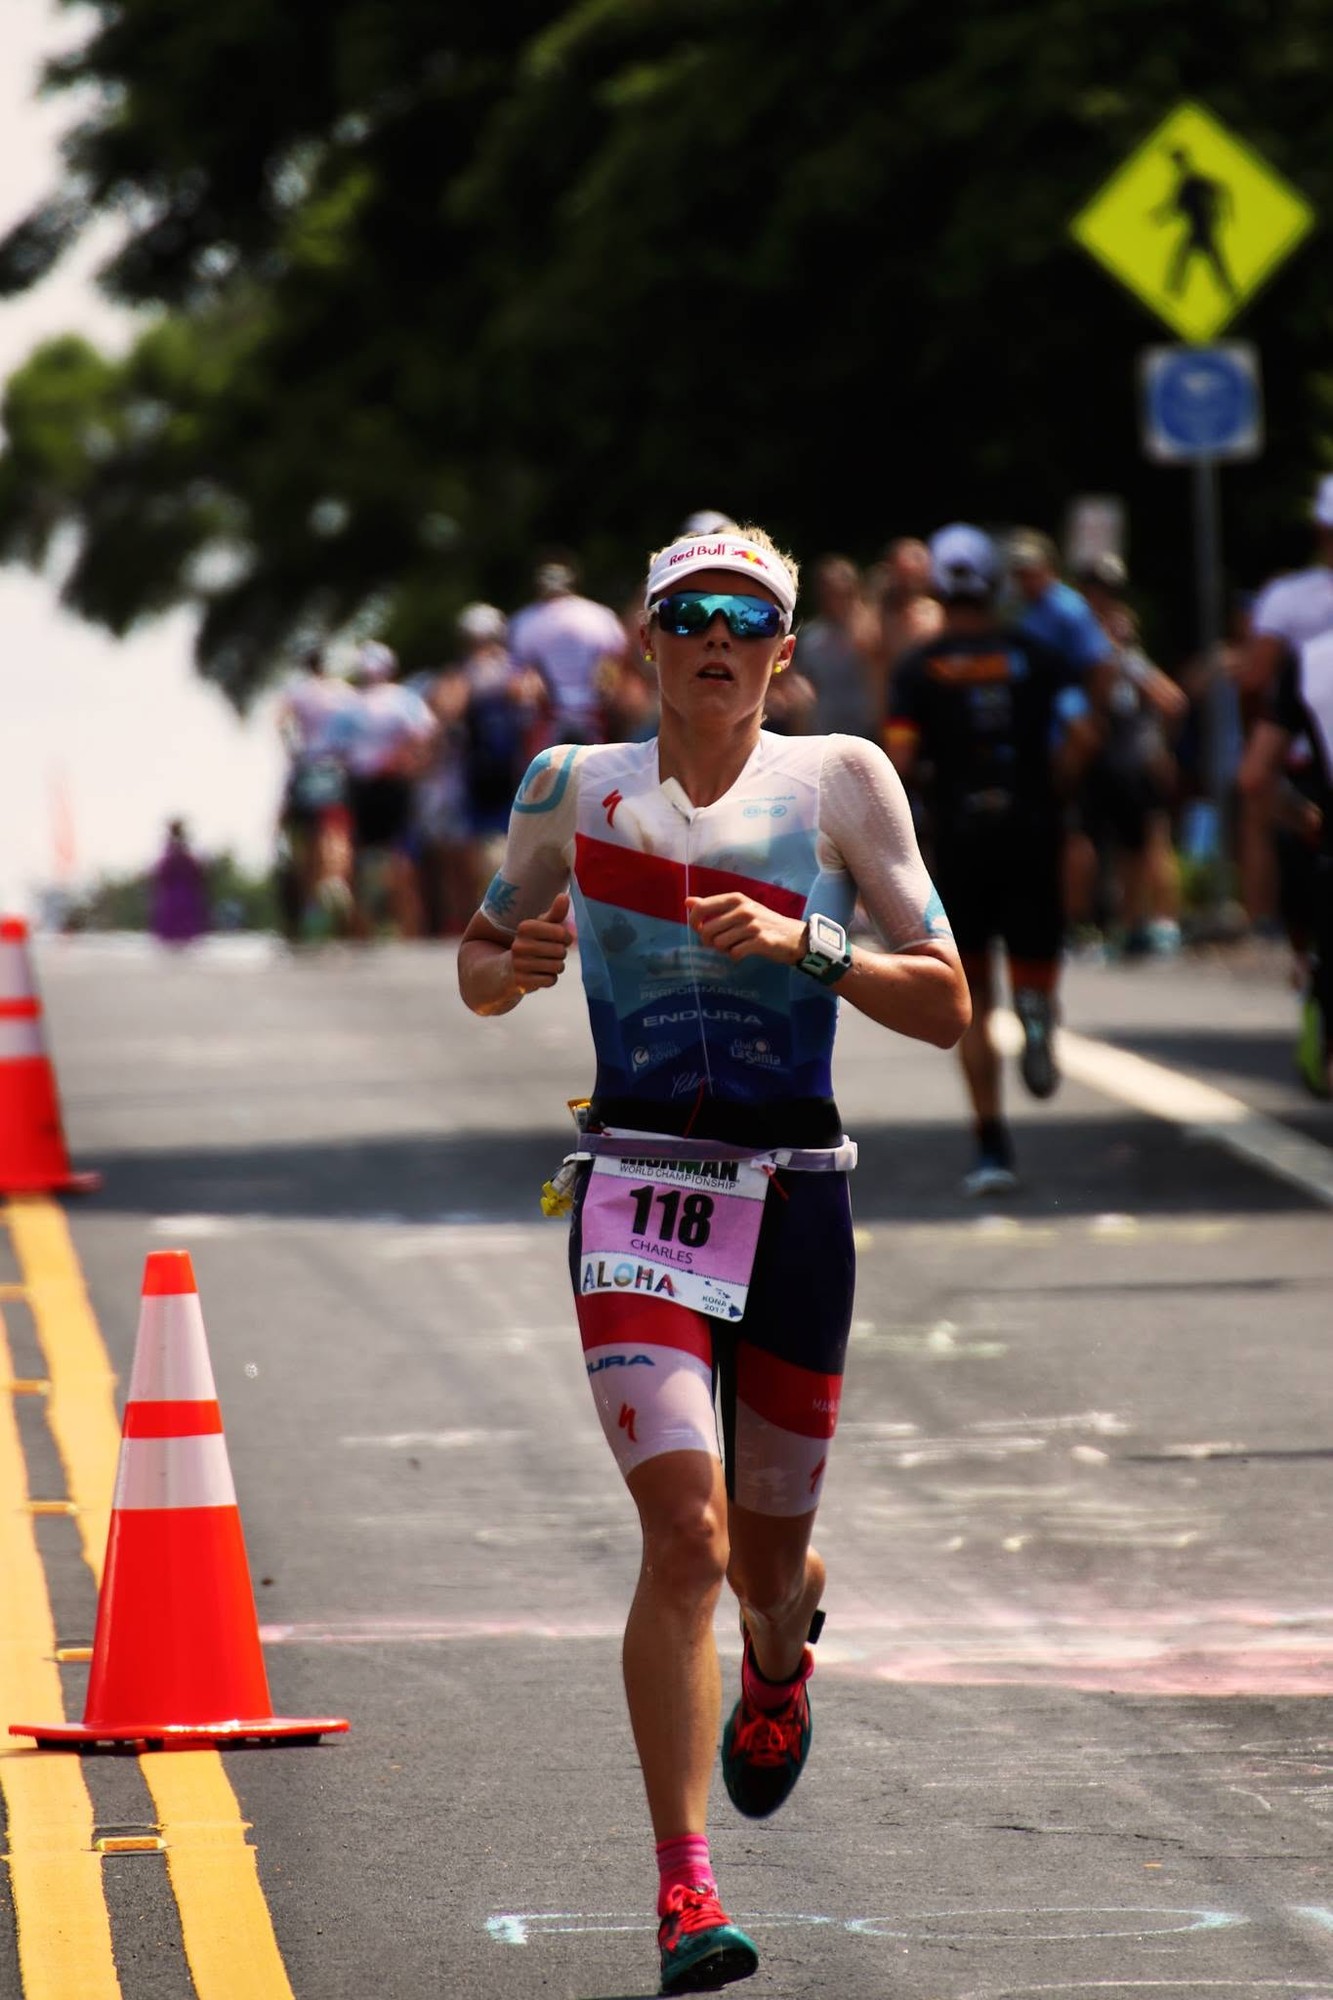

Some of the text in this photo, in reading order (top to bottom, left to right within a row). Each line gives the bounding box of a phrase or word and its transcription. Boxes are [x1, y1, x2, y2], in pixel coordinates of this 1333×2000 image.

[669, 544, 725, 566] Red Bull
[643, 1010, 763, 1027] ENDURA
[620, 1163, 737, 1190] WORLD CHAMPIONSHIP
[629, 1184, 715, 1248] 118
[630, 1238, 694, 1264] CHARLES
[583, 1261, 676, 1298] ALOHA
[702, 1296, 727, 1307] KONA
[704, 1303, 725, 1313] 2017
[586, 1354, 656, 1376] URA
